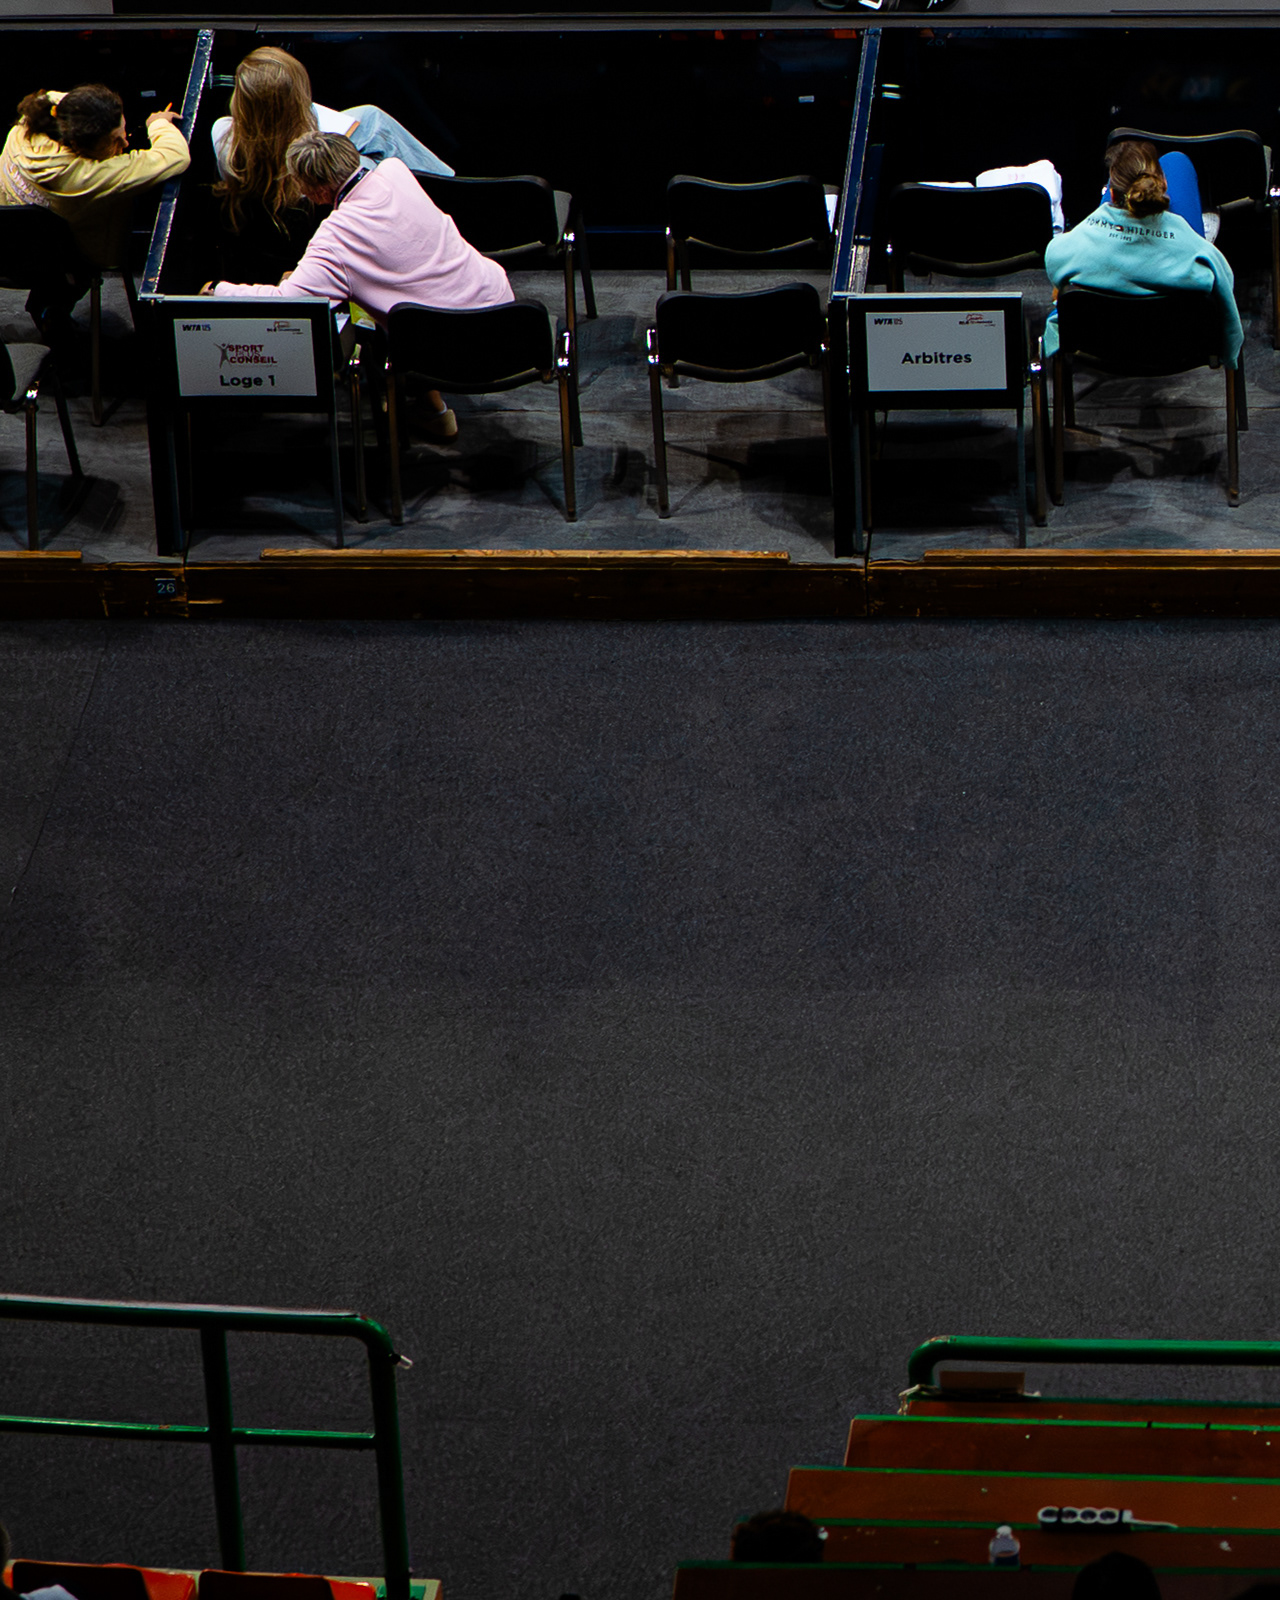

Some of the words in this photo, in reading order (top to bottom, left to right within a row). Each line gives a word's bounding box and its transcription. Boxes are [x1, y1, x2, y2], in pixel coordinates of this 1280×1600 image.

[1086, 218, 1113, 229] TOMMY
[1126, 226, 1175, 239] HILFIGER
[228, 344, 264, 352] SPORT
[230, 356, 277, 364] CONSEIL
[901, 352, 972, 364] Arbitres
[220, 375, 263, 388] Loge
[268, 375, 275, 386] 1
[157, 582, 176, 594] 26
